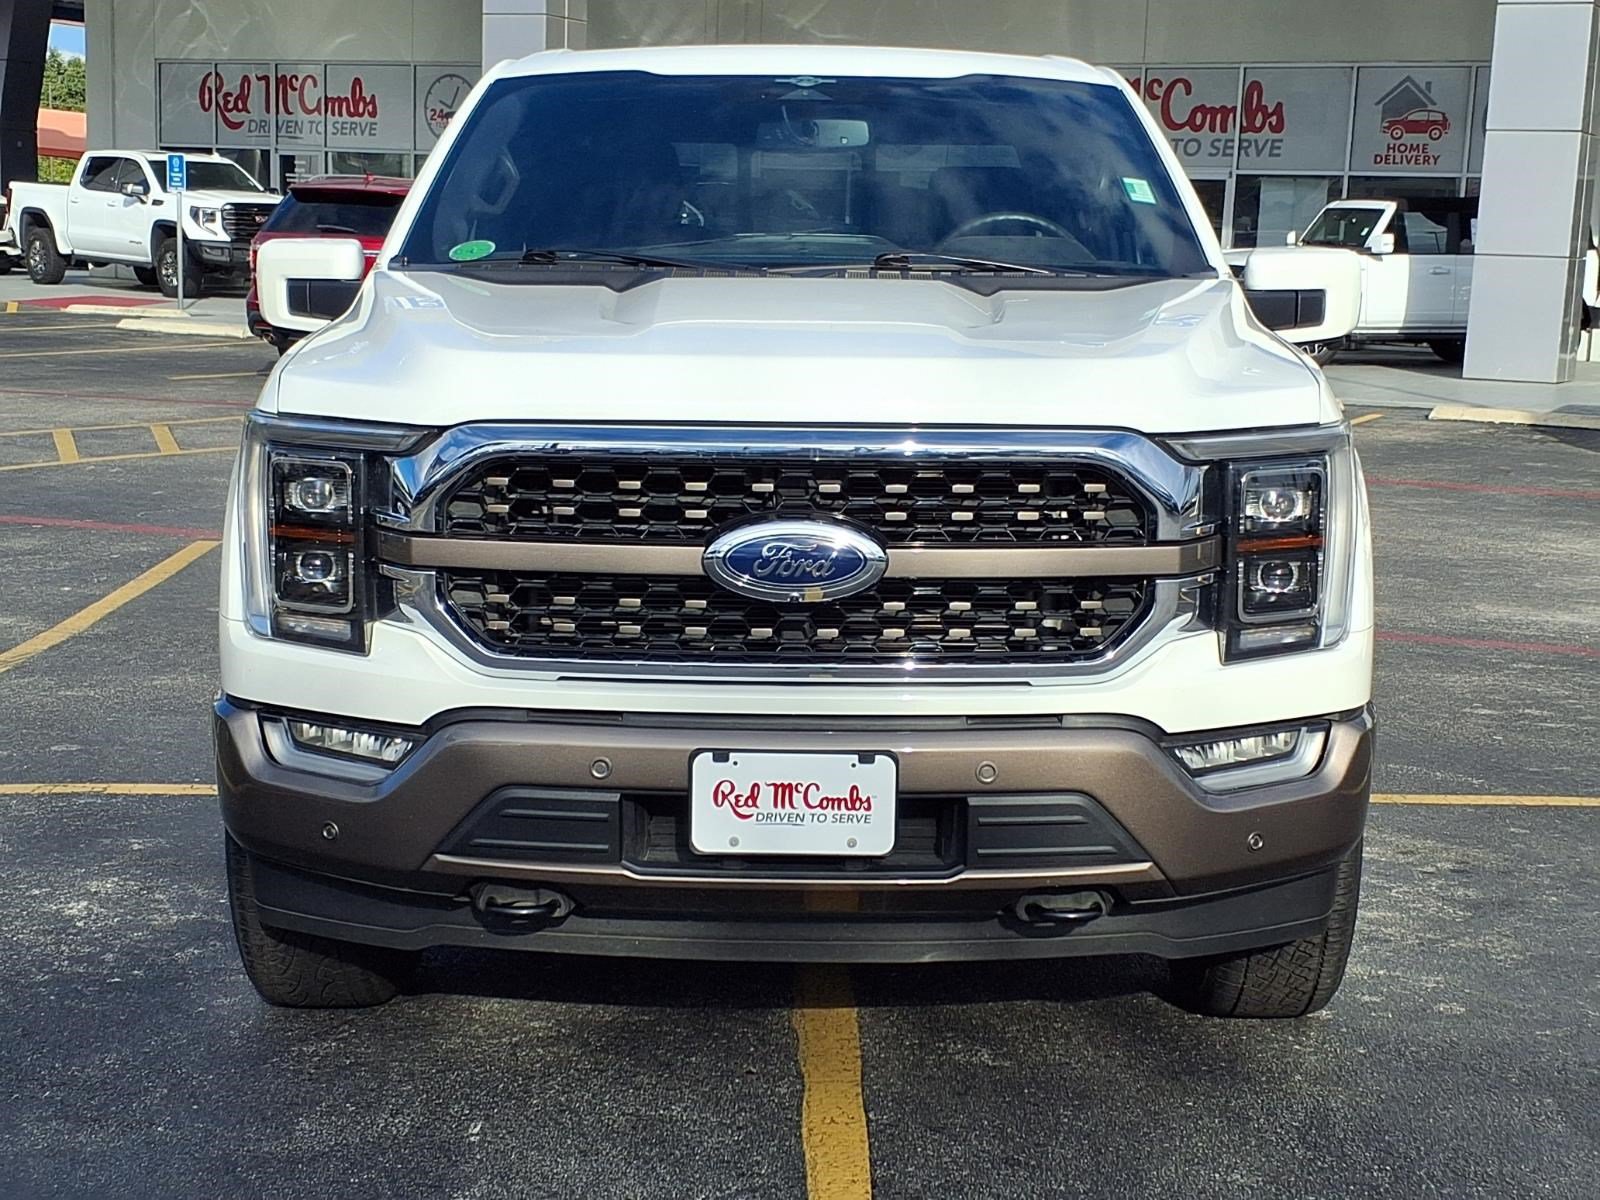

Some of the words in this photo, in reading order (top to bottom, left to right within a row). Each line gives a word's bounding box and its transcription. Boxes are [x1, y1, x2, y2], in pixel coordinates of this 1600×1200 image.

[199, 71, 251, 130] Red
[248, 119, 304, 135] DRIVEN
[308, 121, 323, 135] TO
[332, 121, 378, 137] SERVE
[1171, 138, 1201, 157] TO
[1208, 138, 1283, 158] SERVE
[1386, 143, 1430, 154] HOME
[1373, 154, 1441, 166] DELIVERY
[753, 542, 836, 578] Ford
[713, 779, 761, 820] Red
[765, 782, 873, 812] McCombs
[755, 812, 805, 824] DRIVEN
[809, 812, 828, 824] TO
[831, 813, 872, 824] SERVE
